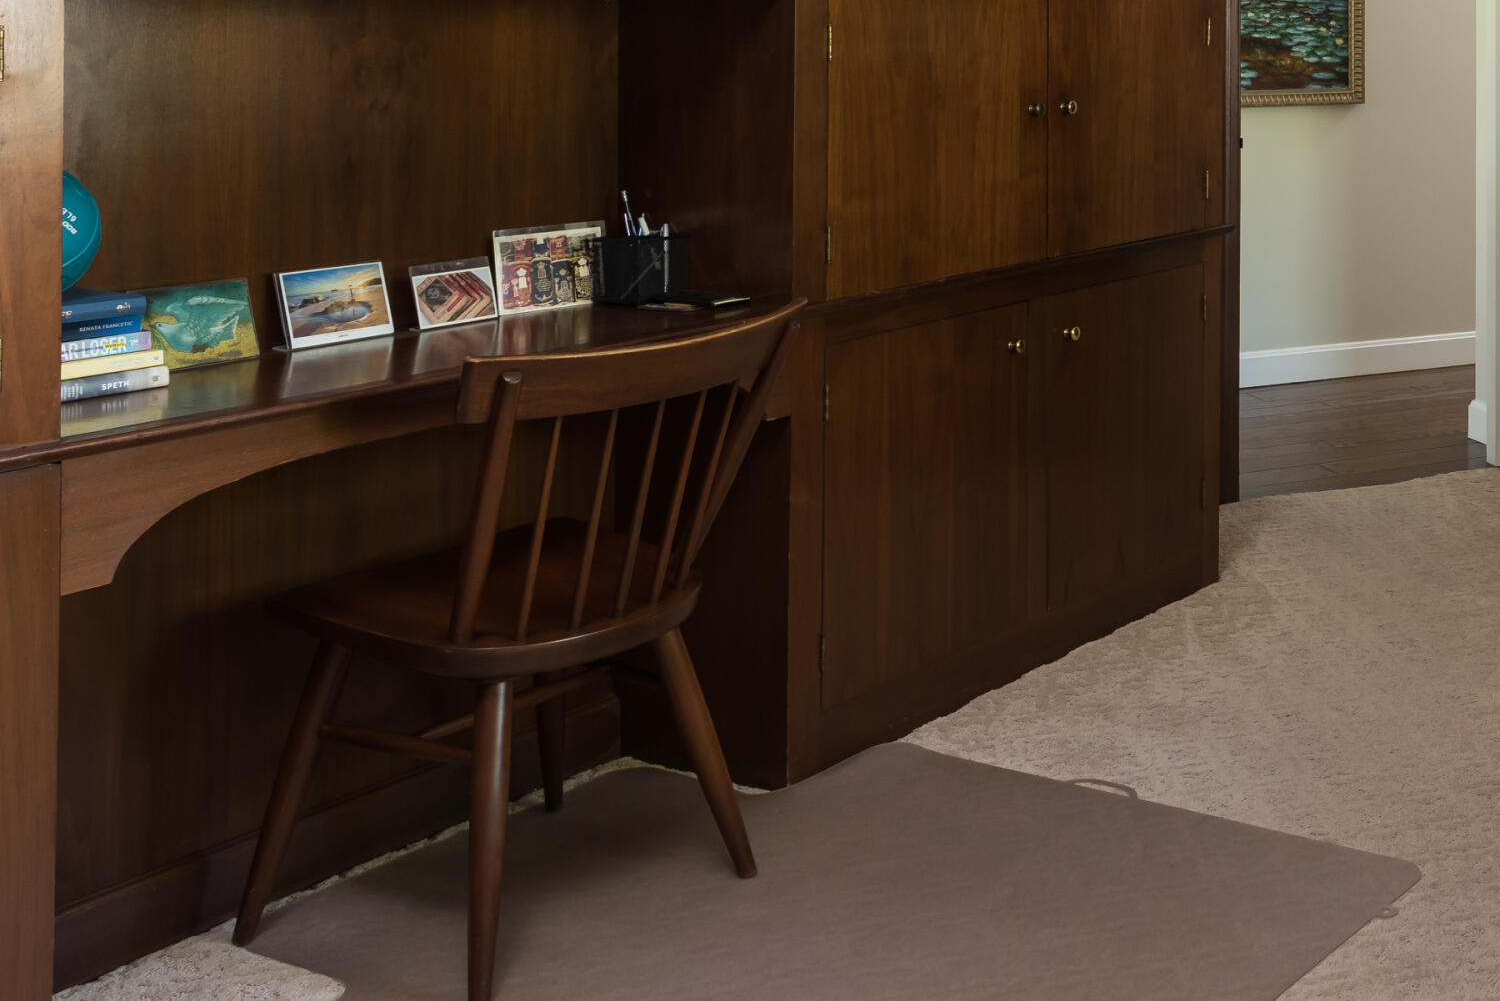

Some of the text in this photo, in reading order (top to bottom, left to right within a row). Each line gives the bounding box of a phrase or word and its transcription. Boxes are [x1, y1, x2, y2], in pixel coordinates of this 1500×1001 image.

[79, 319, 134, 333] RENATA FRANCETIC
[81, 335, 128, 360] LOSER
[101, 380, 131, 391] SPETH
